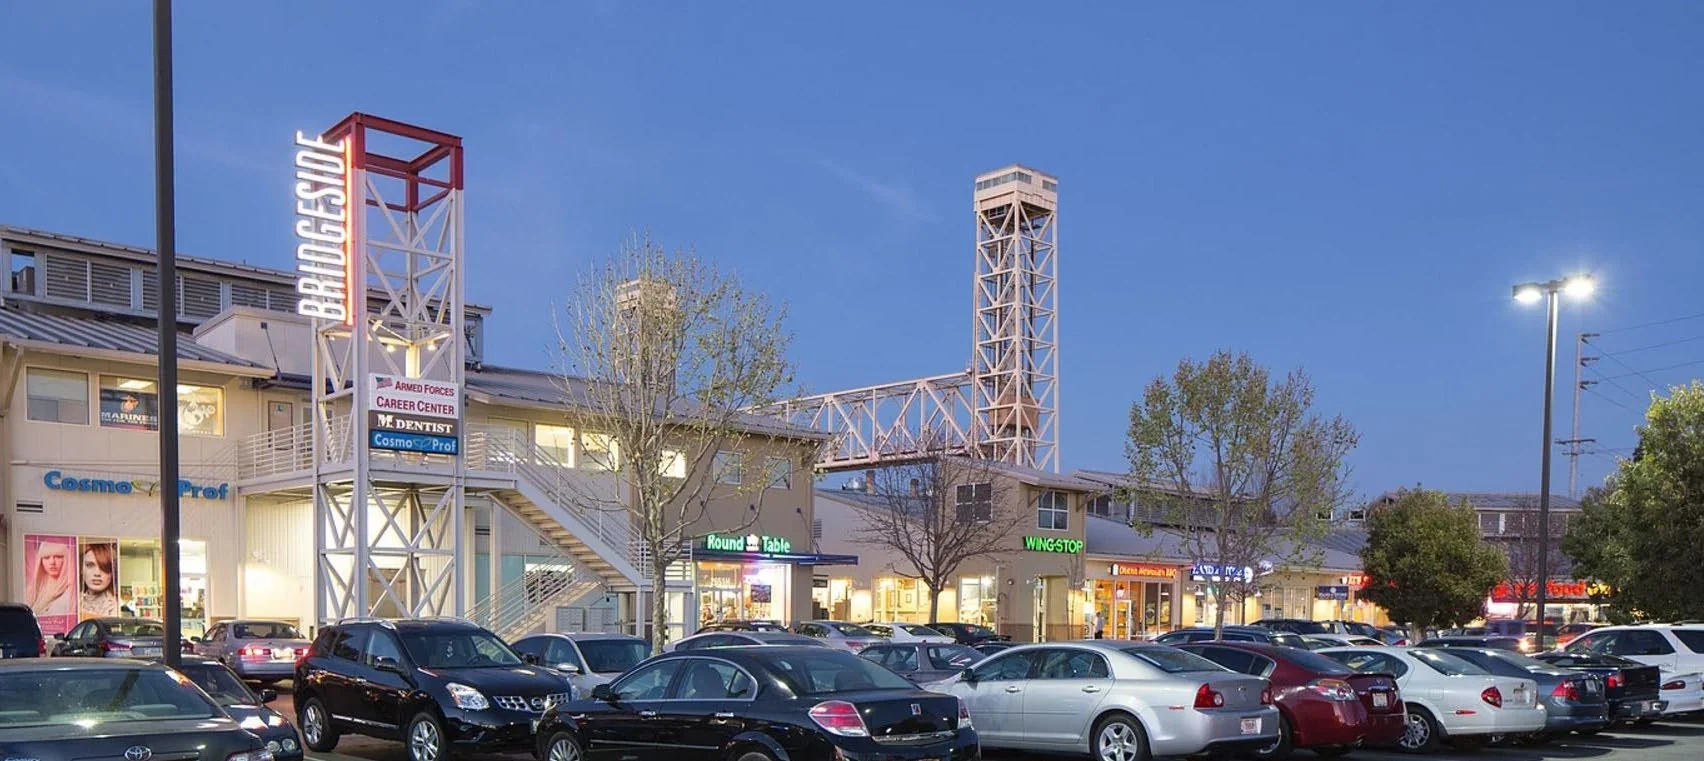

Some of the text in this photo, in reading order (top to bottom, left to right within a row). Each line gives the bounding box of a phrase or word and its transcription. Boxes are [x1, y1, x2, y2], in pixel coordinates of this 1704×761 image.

[296, 130, 347, 321] BRIDGESIDE
[395, 381, 455, 397] ARMED FORCES
[376, 396, 454, 415] CAREER CENTER
[395, 419, 453, 433] DENTIST
[374, 433, 457, 452] Cosmo Prof
[44, 470, 229, 500] Cosmo Prof
[707, 534, 790, 553] Round Table
